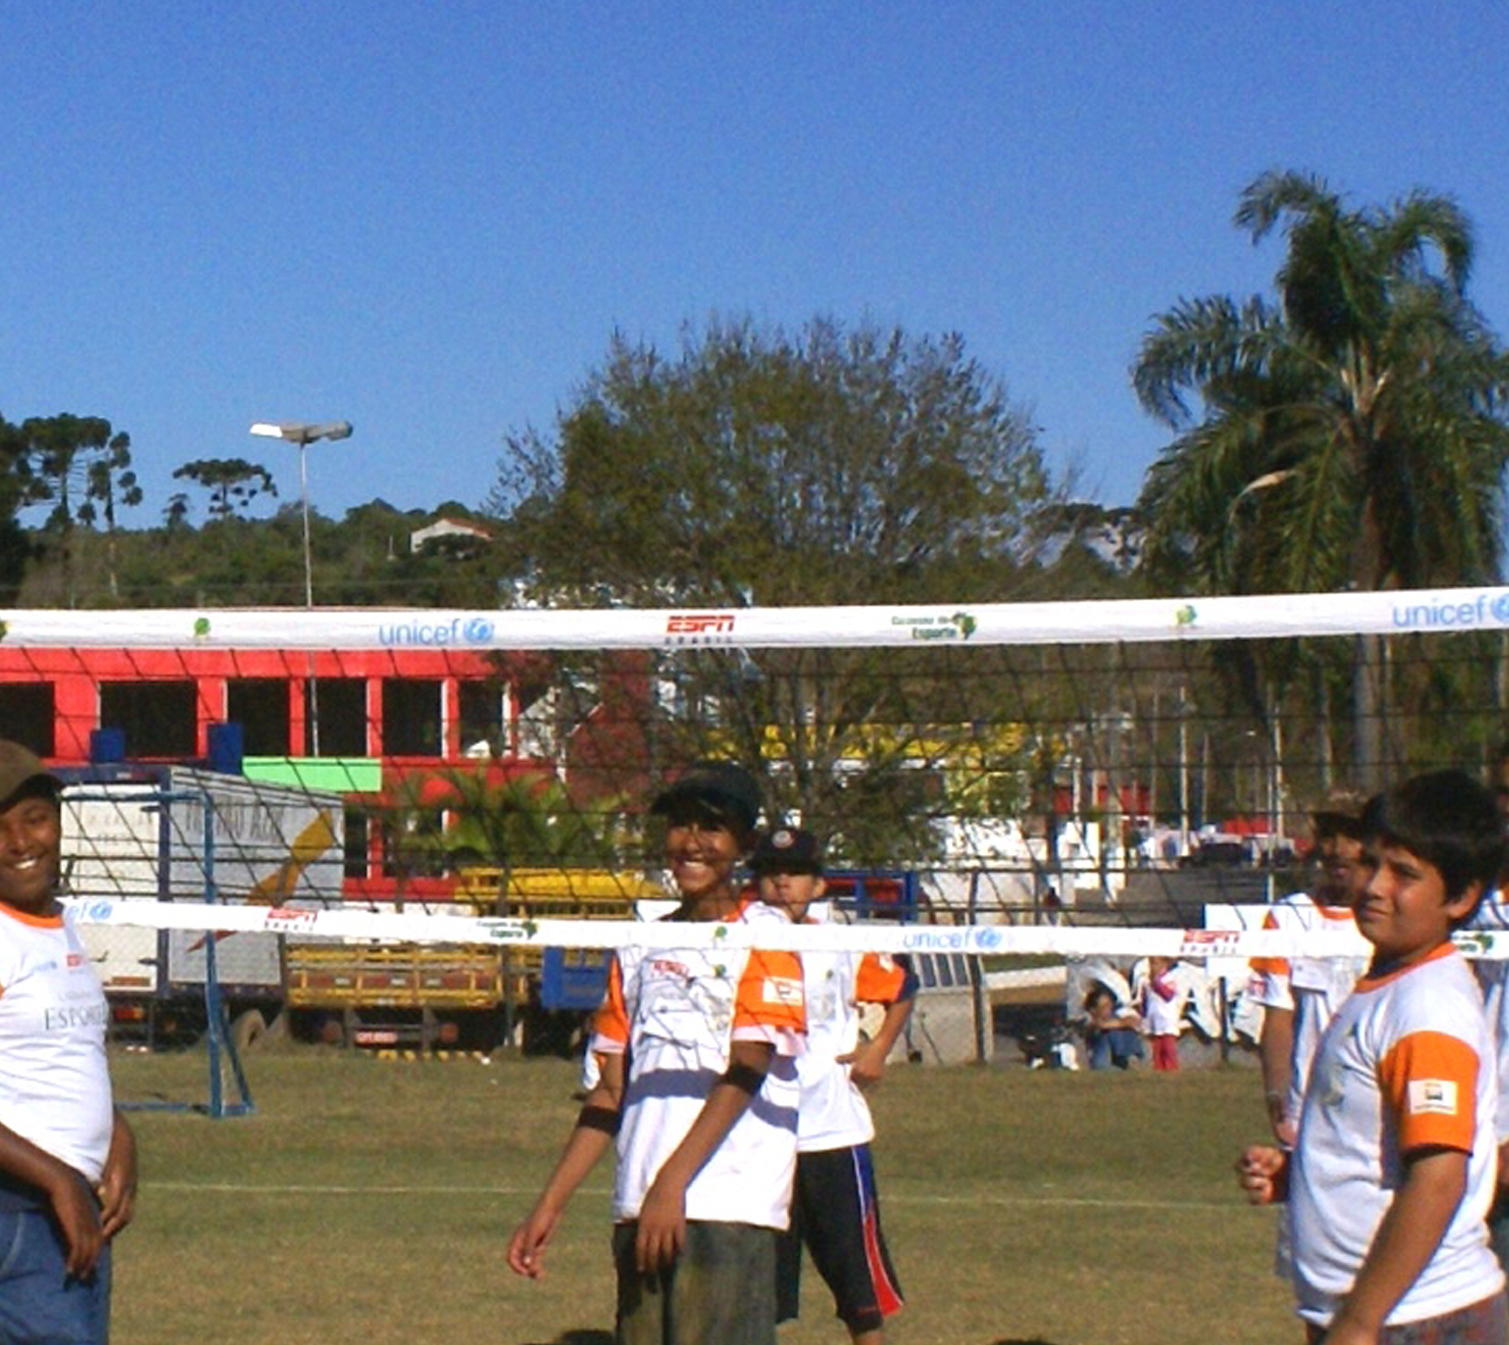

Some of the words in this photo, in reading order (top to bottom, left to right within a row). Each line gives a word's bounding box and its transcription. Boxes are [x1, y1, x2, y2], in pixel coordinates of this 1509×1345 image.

[1393, 596, 1487, 627] unicef
[379, 617, 461, 645] unicef
[667, 615, 734, 632] ESPN
[903, 930, 972, 948] unicef
